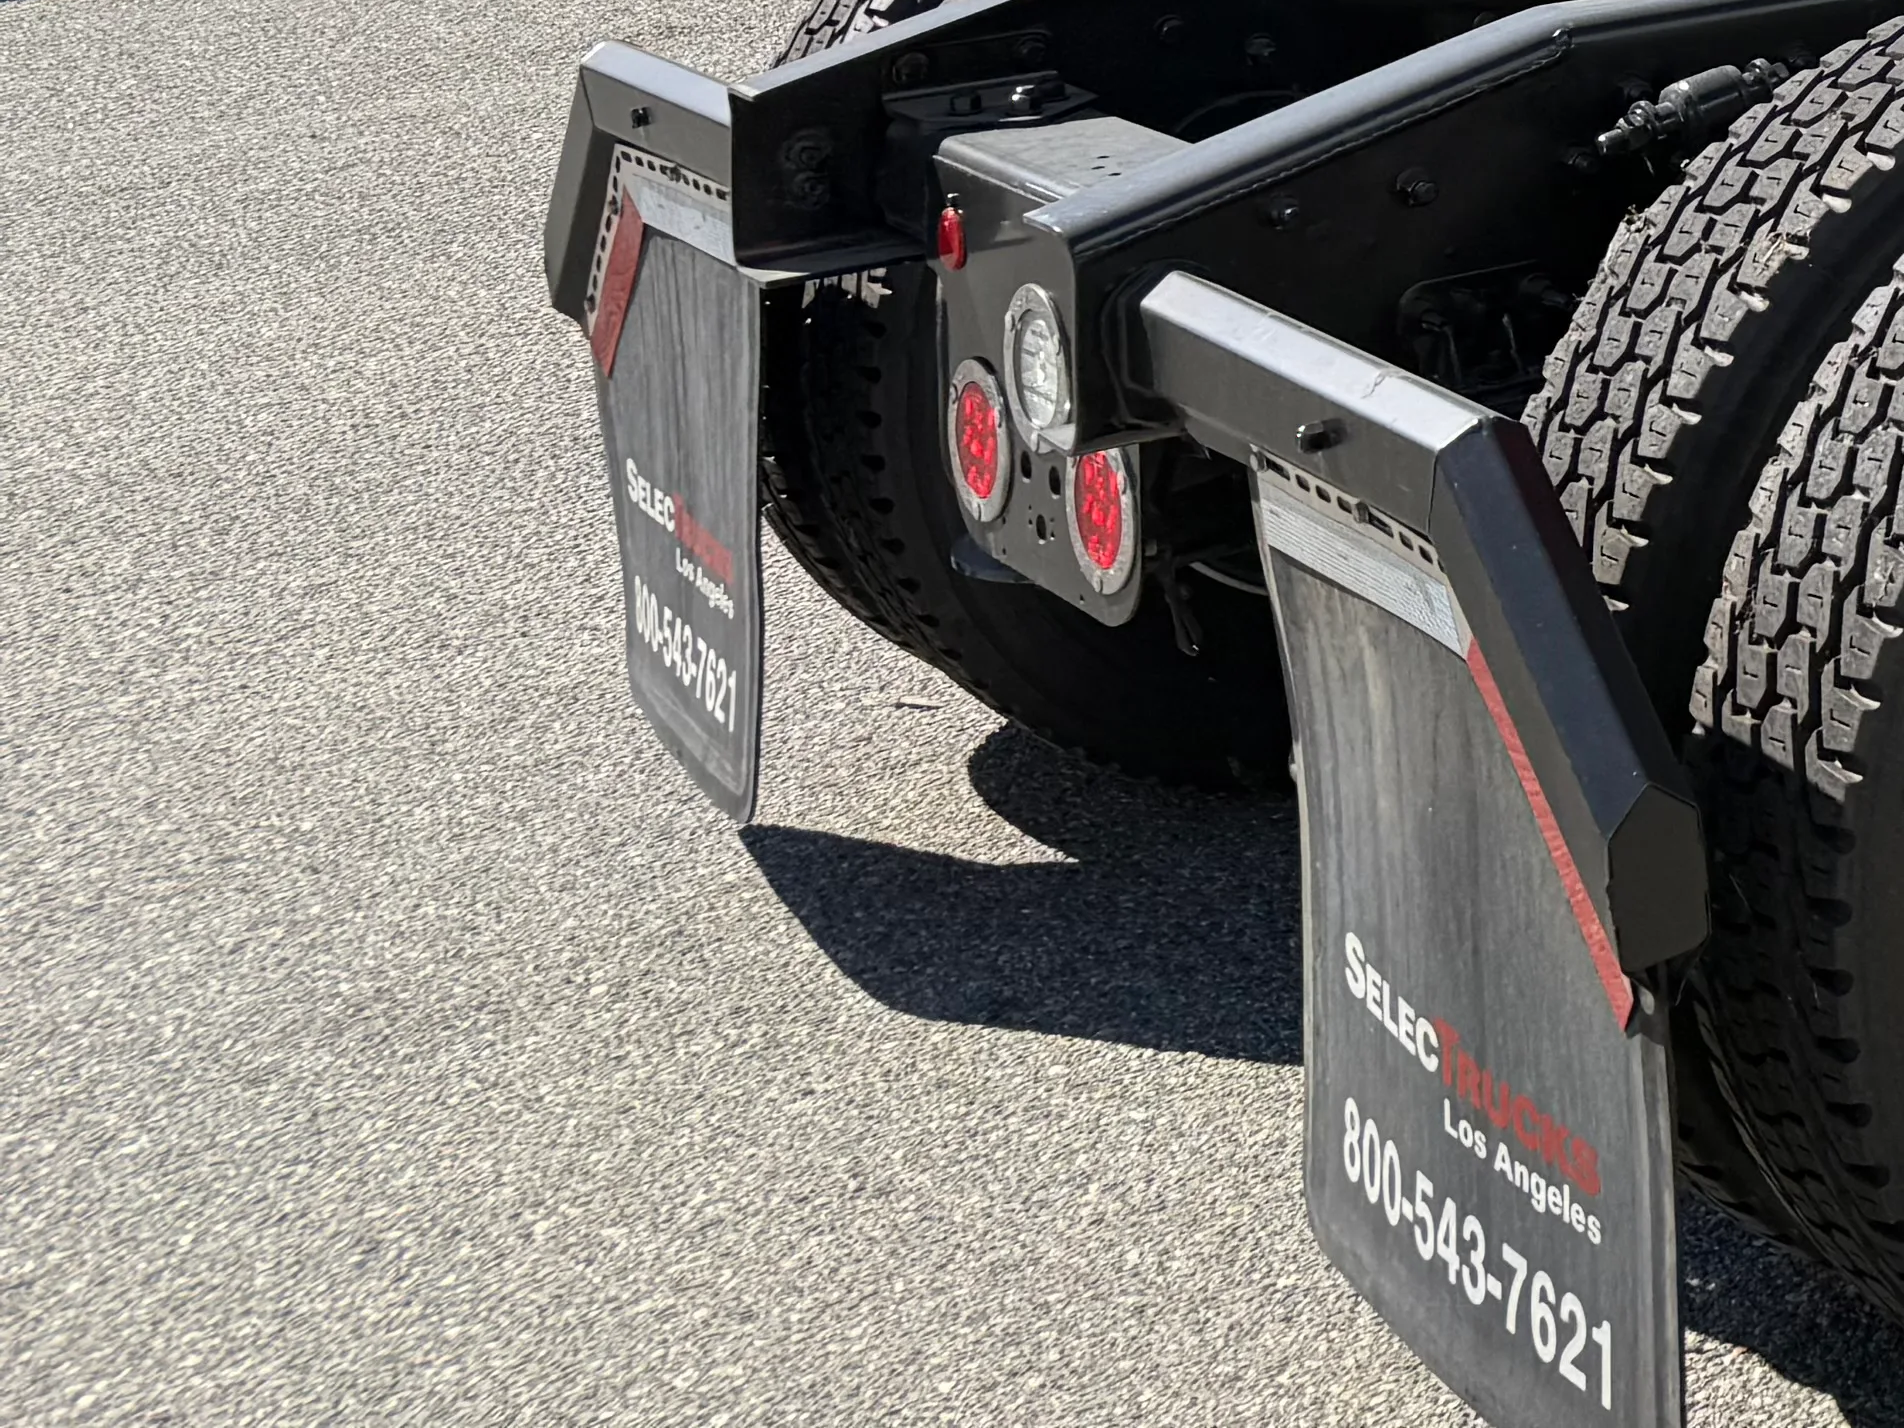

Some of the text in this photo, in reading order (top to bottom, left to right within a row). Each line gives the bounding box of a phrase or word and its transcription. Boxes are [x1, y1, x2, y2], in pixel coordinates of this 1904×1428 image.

[633, 574, 737, 733] 800-543-7621
[675, 546, 735, 620] Los Angeles
[1344, 931, 1602, 1198] SELECTRUCKS
[1443, 1097, 1603, 1245] Los Angeles
[1343, 1095, 1612, 1412] 800-543-7621
